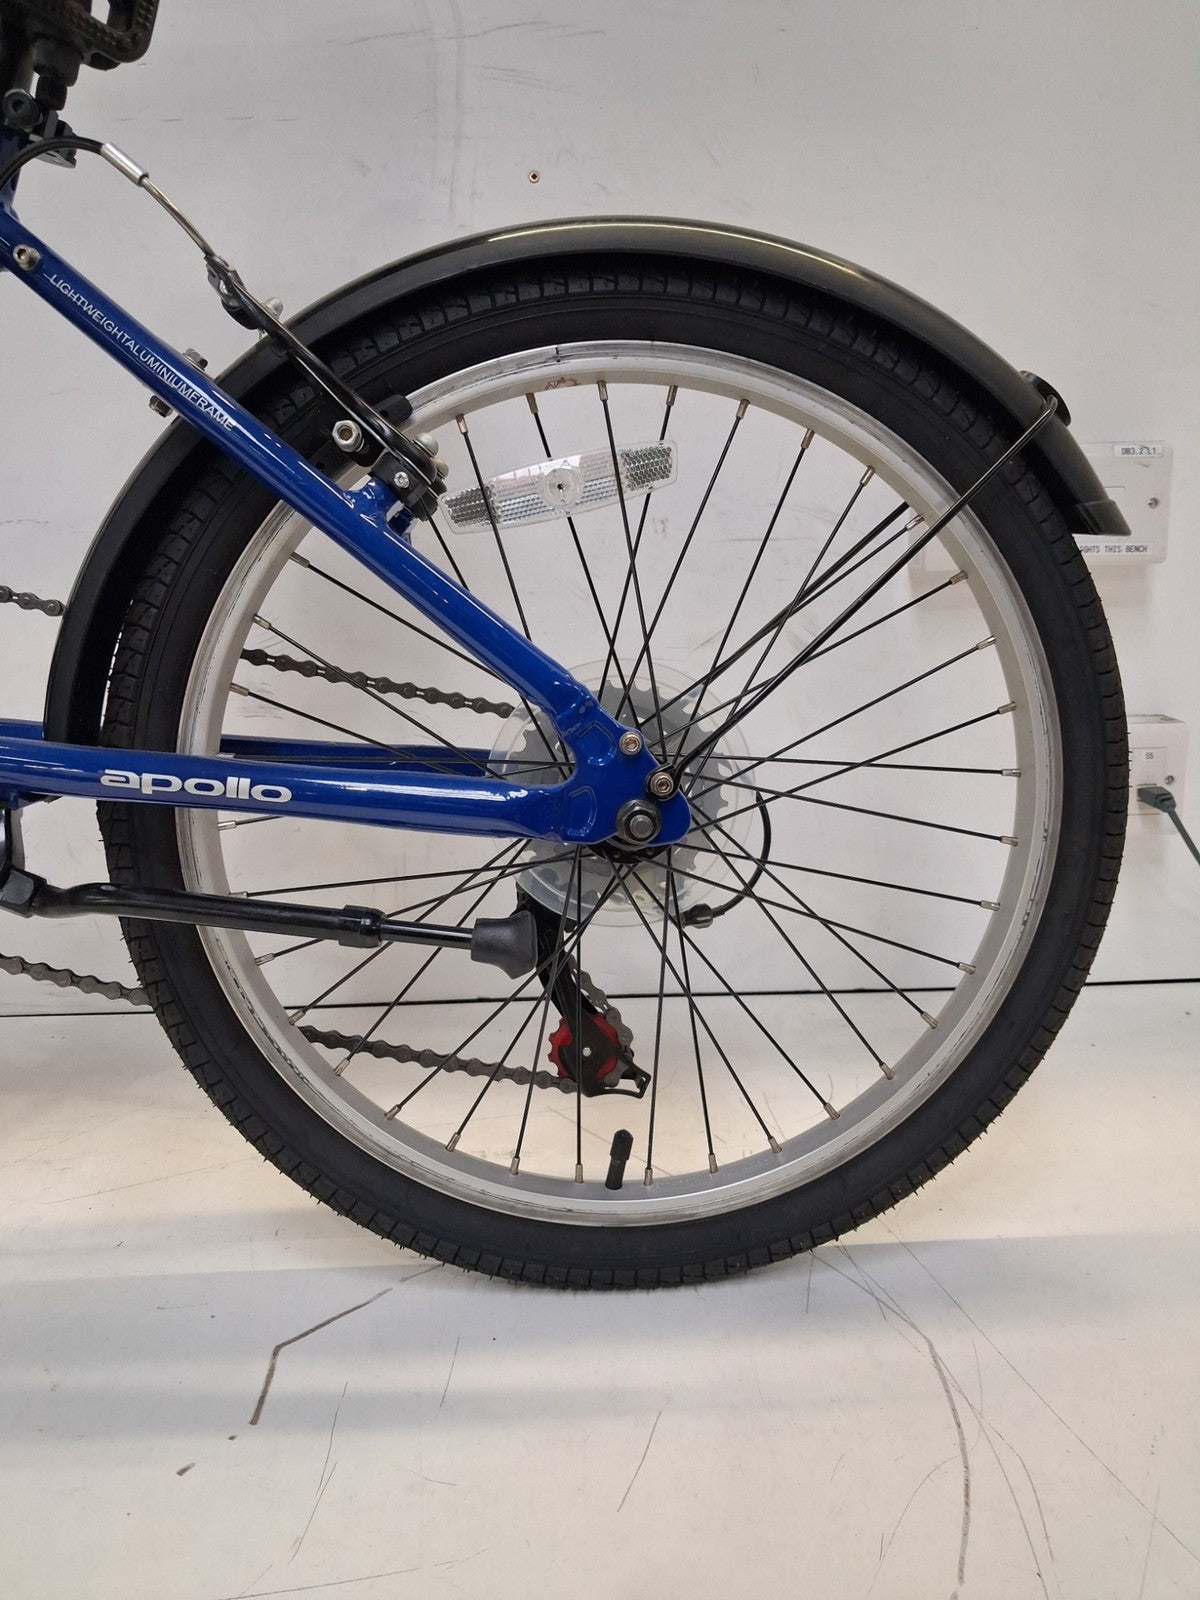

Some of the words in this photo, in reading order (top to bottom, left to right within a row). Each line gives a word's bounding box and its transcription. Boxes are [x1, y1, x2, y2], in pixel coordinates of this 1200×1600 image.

[1104, 545, 1122, 553] THIS
[1125, 545, 1148, 553] BENCH
[100, 769, 293, 803] apollo
